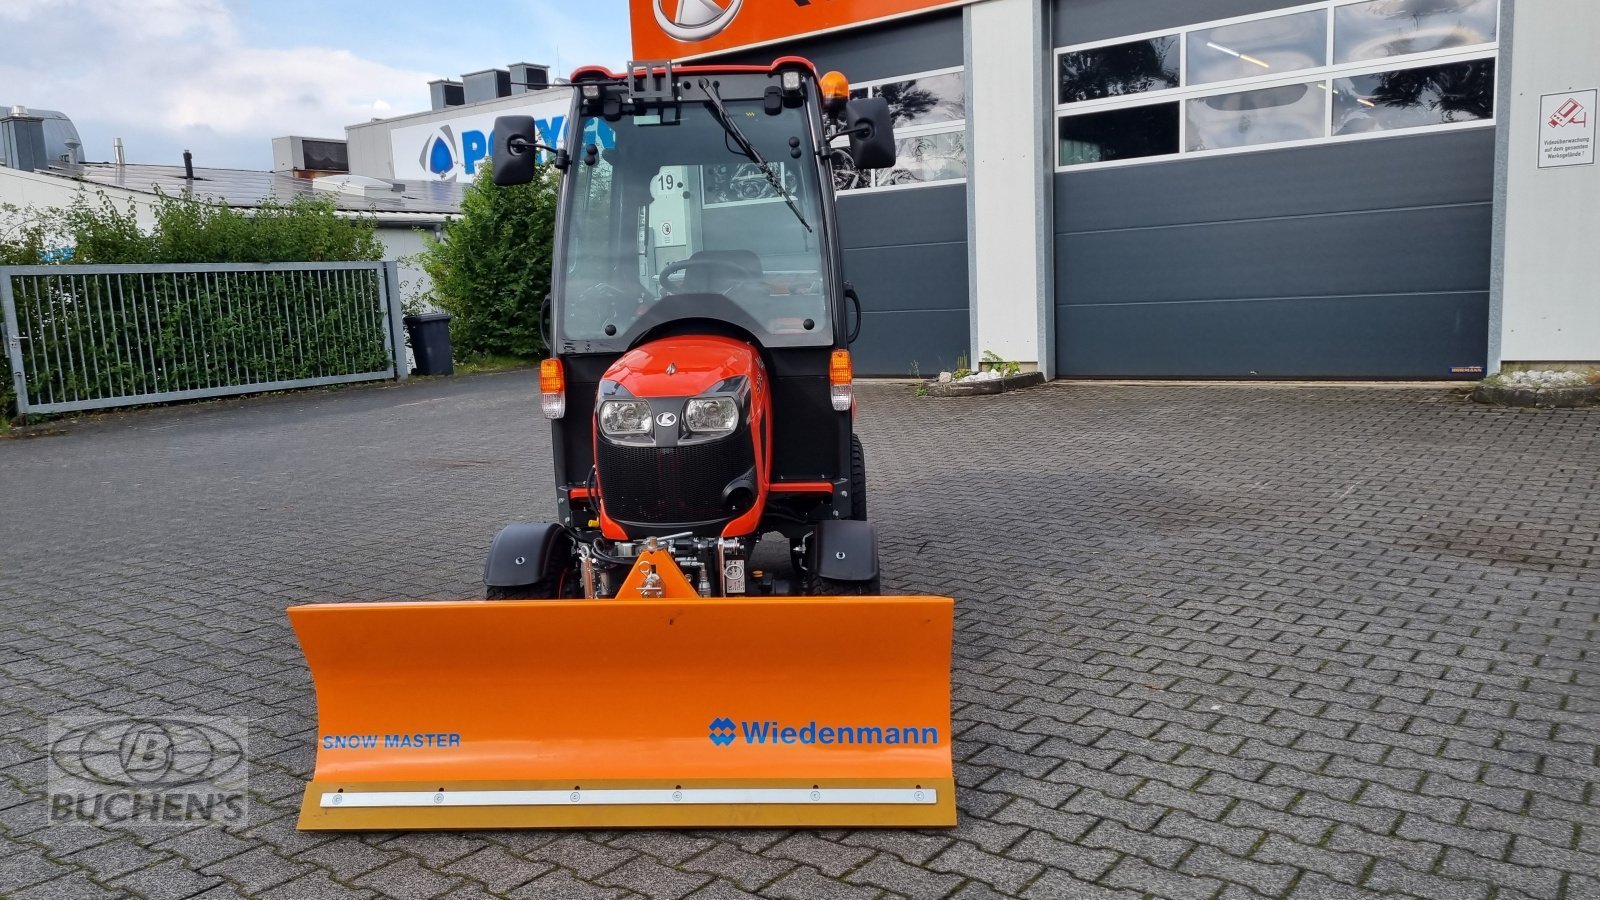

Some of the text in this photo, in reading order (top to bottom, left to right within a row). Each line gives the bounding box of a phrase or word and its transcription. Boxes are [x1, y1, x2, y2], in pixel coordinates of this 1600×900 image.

[1544, 137, 1589, 145] Videoüberwachung
[1565, 144, 1589, 152] gesamten
[658, 174, 674, 191] 19
[322, 733, 461, 749] SNOW MASTER
[742, 721, 938, 745] Wiedenmann
